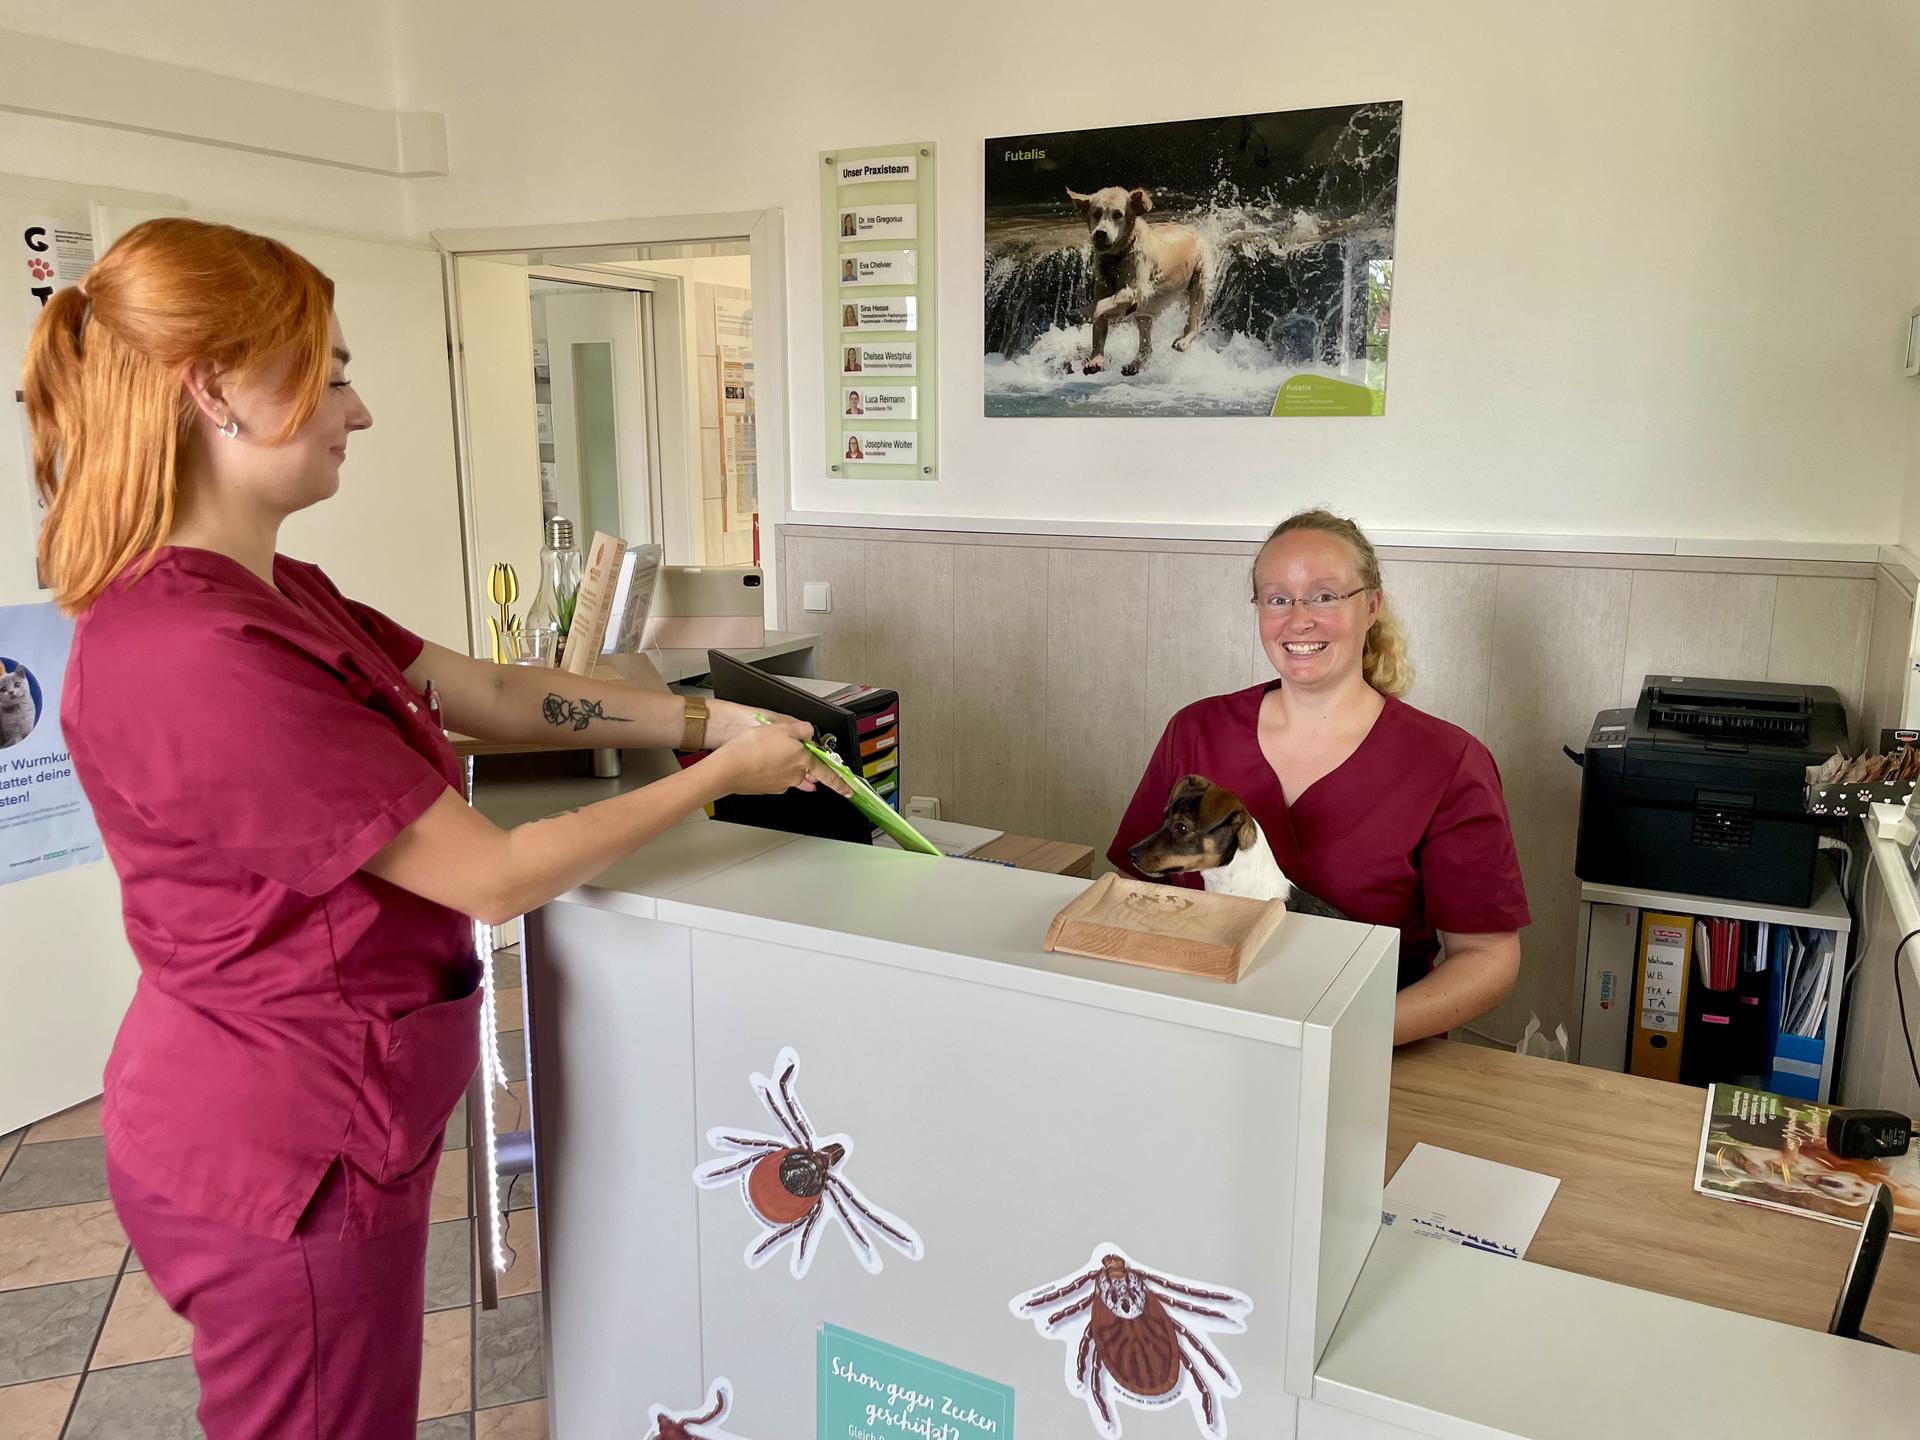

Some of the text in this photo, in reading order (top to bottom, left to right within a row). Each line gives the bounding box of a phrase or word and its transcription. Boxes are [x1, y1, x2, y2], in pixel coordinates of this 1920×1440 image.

[1004, 148, 1046, 162] futalis
[842, 164, 910, 178] Unser Praxisteam
[876, 215, 904, 225] Gregorius
[860, 261, 869, 270] Eva
[860, 304, 889, 312] Sina Hesse
[863, 351, 912, 362] Chelsea Westphal
[865, 394, 906, 404] Luca Reimann
[865, 439, 913, 450] Josephine Wolter
[11, 752, 71, 771] Wurmkur
[36, 768, 72, 783] deine
[831, 1356, 997, 1433] Schon gegen Zecken
